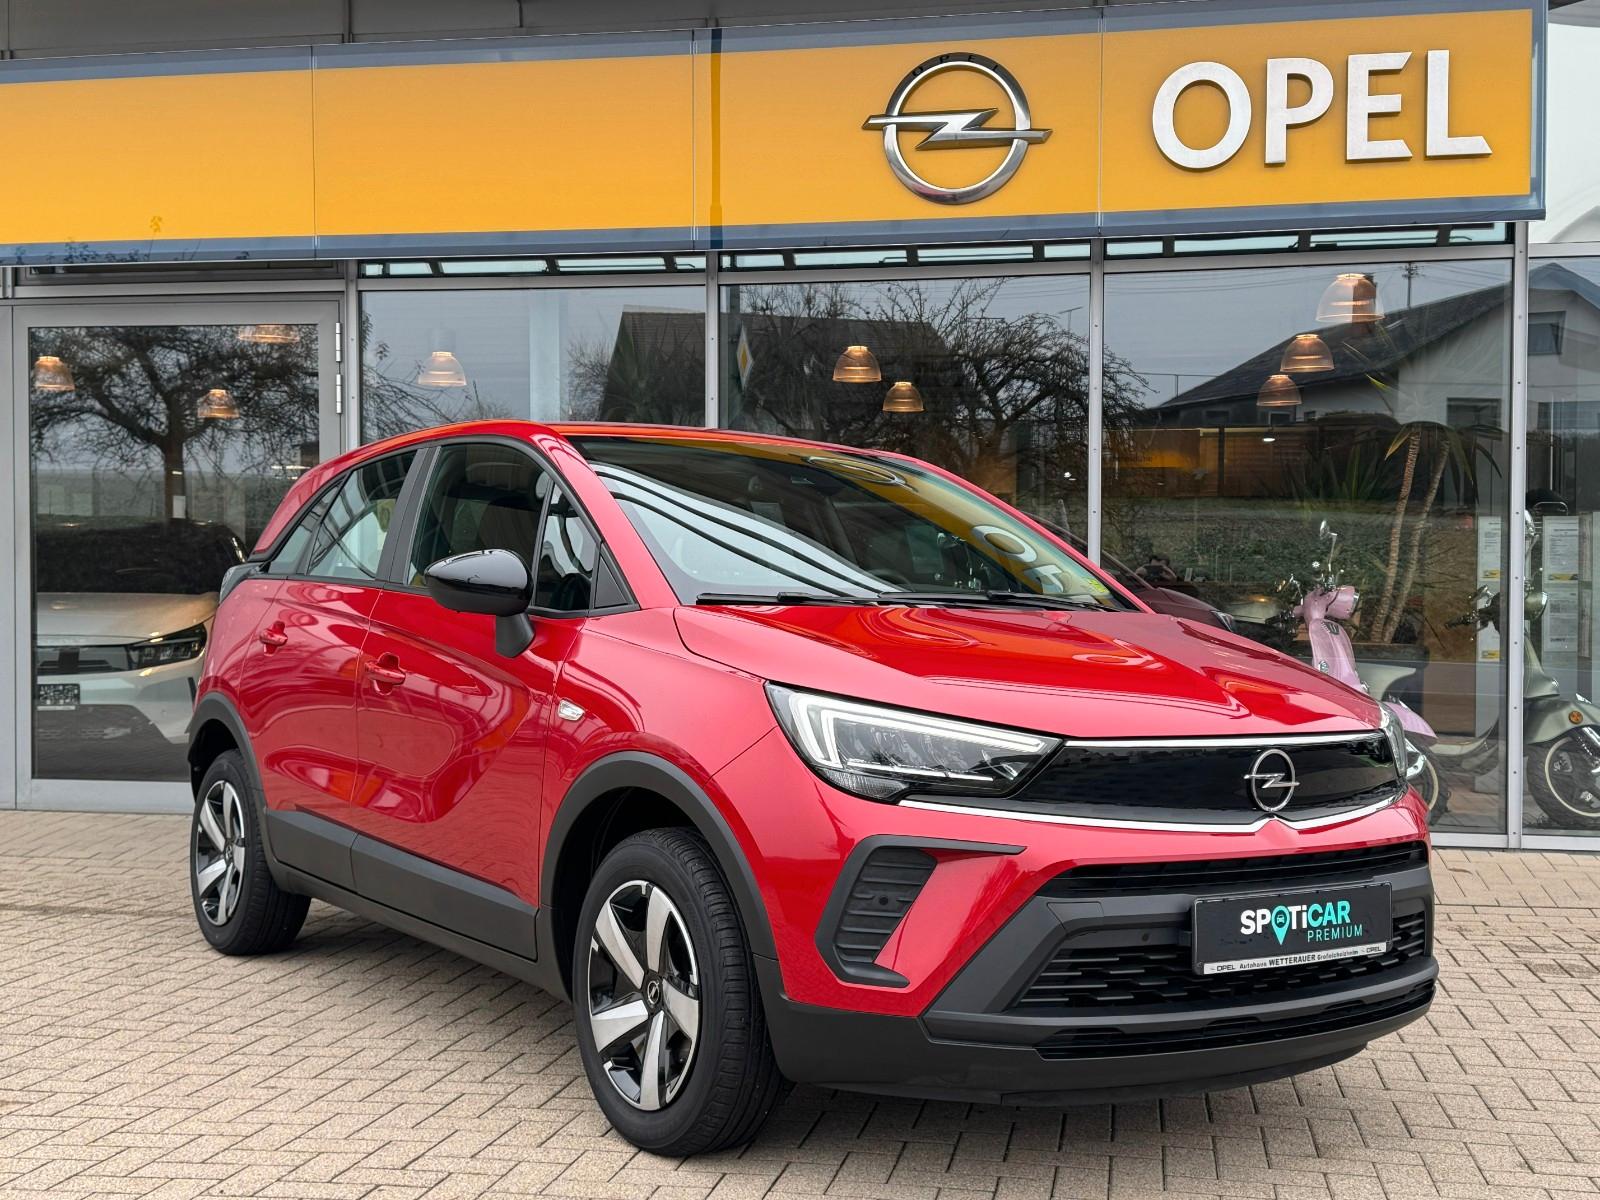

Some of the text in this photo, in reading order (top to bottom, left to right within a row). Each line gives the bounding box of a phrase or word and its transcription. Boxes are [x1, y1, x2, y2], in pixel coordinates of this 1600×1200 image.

[1152, 49, 1493, 169] OPEL
[1307, 923, 1363, 943] PREMIUM
[1216, 964, 1236, 972] OPEL
[1239, 961, 1267, 970] Autohaus
[1268, 953, 1316, 967] WETTERAUER
